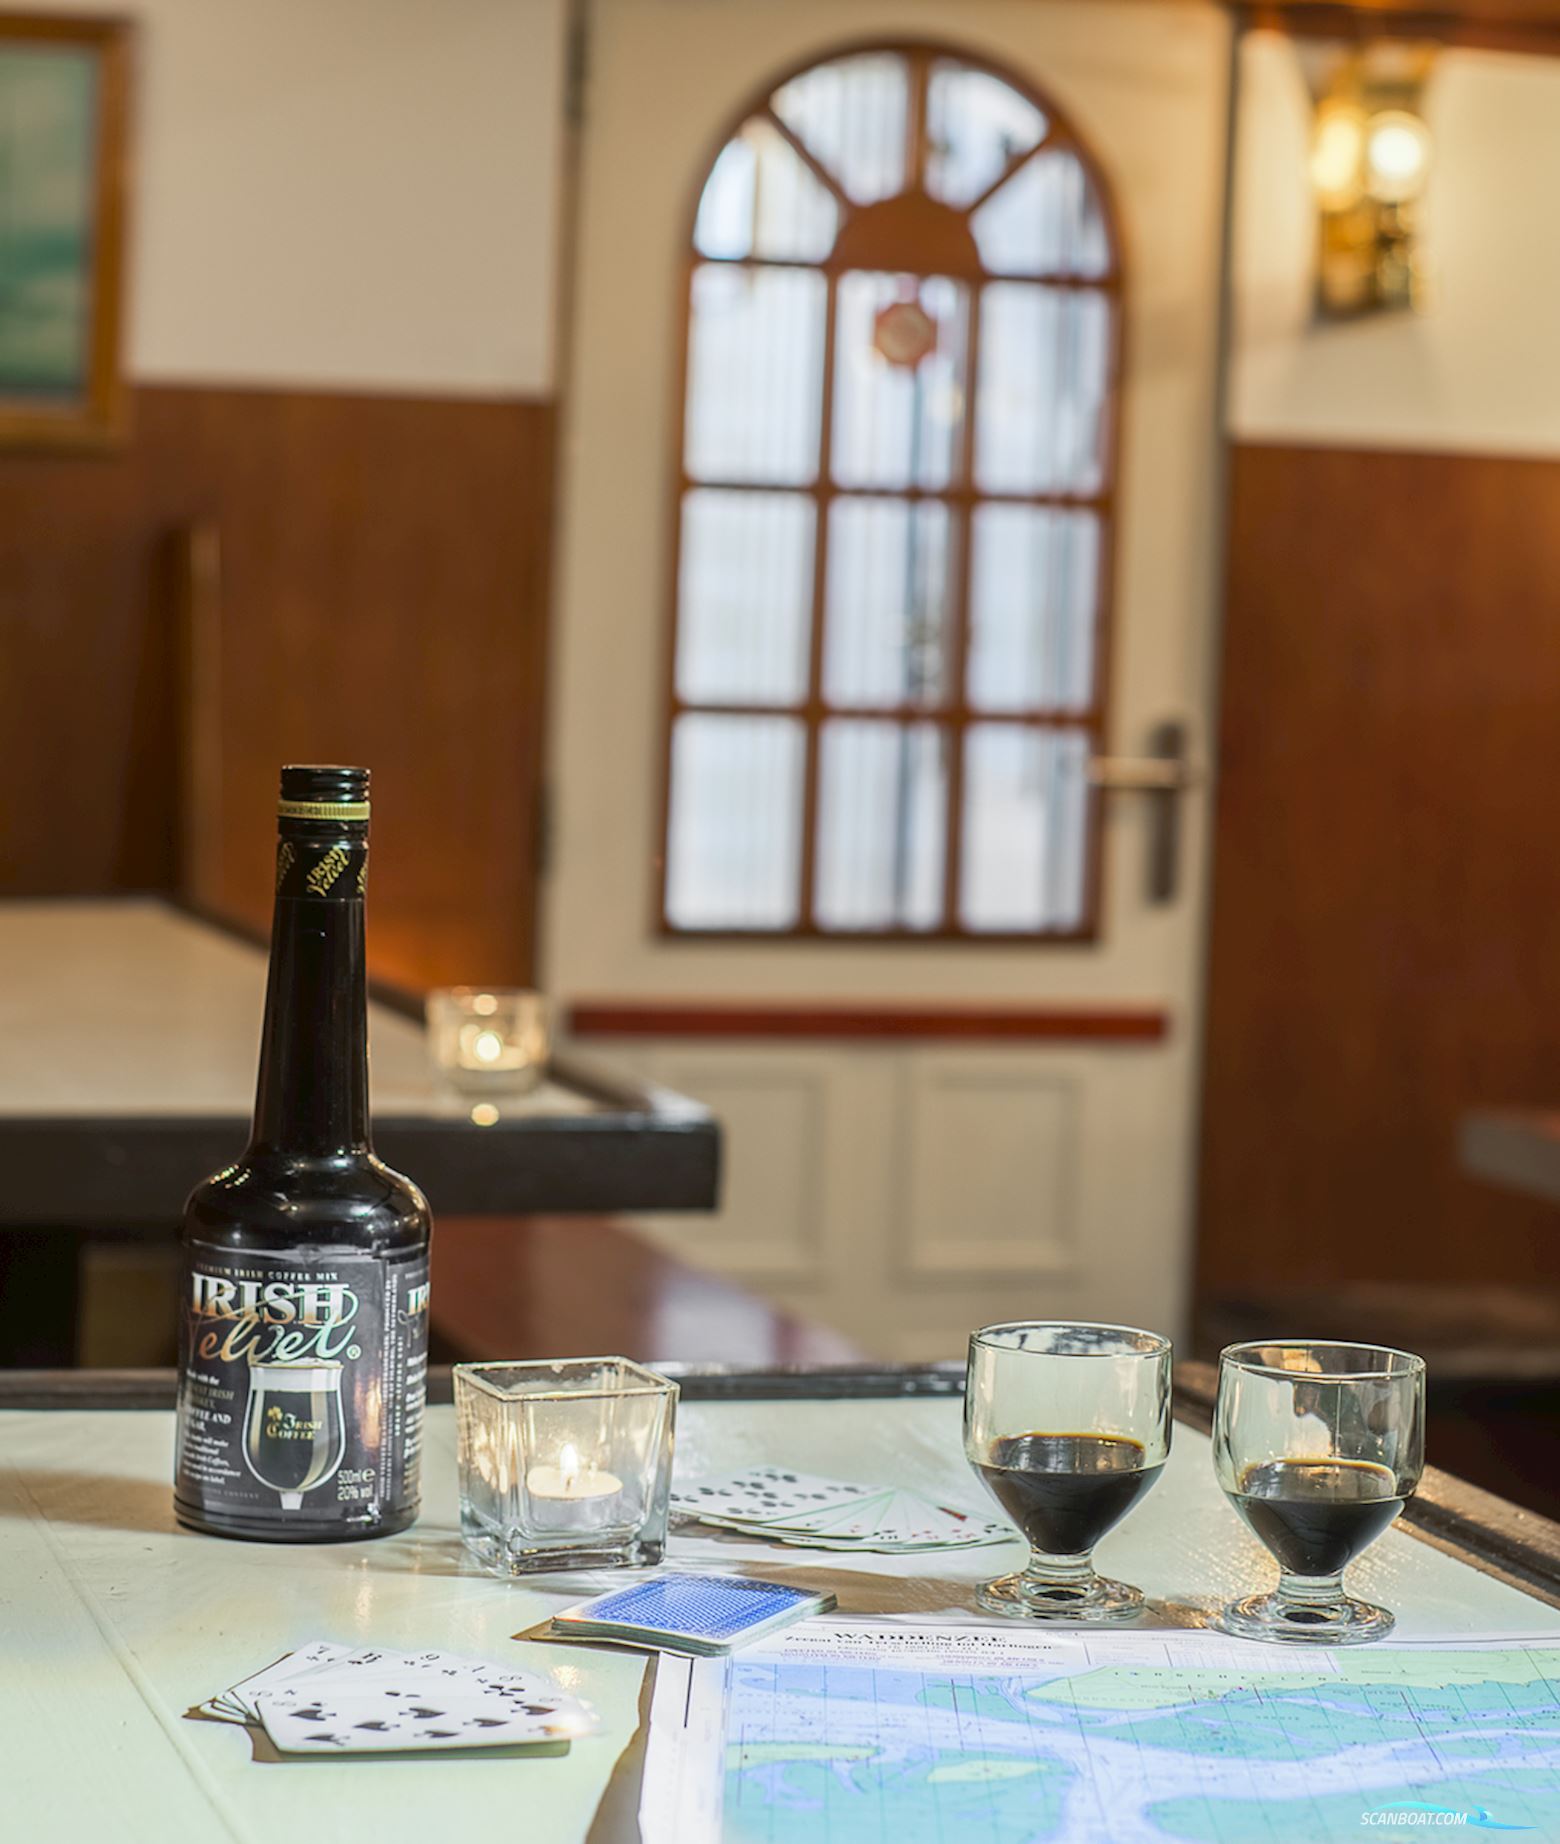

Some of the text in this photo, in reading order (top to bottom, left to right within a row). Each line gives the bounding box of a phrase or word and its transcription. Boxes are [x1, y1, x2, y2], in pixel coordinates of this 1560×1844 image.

[306, 846, 348, 885] IRISH
[233, 1268, 263, 1279] IRISH
[268, 1271, 310, 1282] COFFEE
[315, 1272, 338, 1282] MIX
[192, 1272, 350, 1325] IRISH
[338, 1486, 358, 1501] 20%
[834, 1632, 1006, 1644] WADDENZEE
